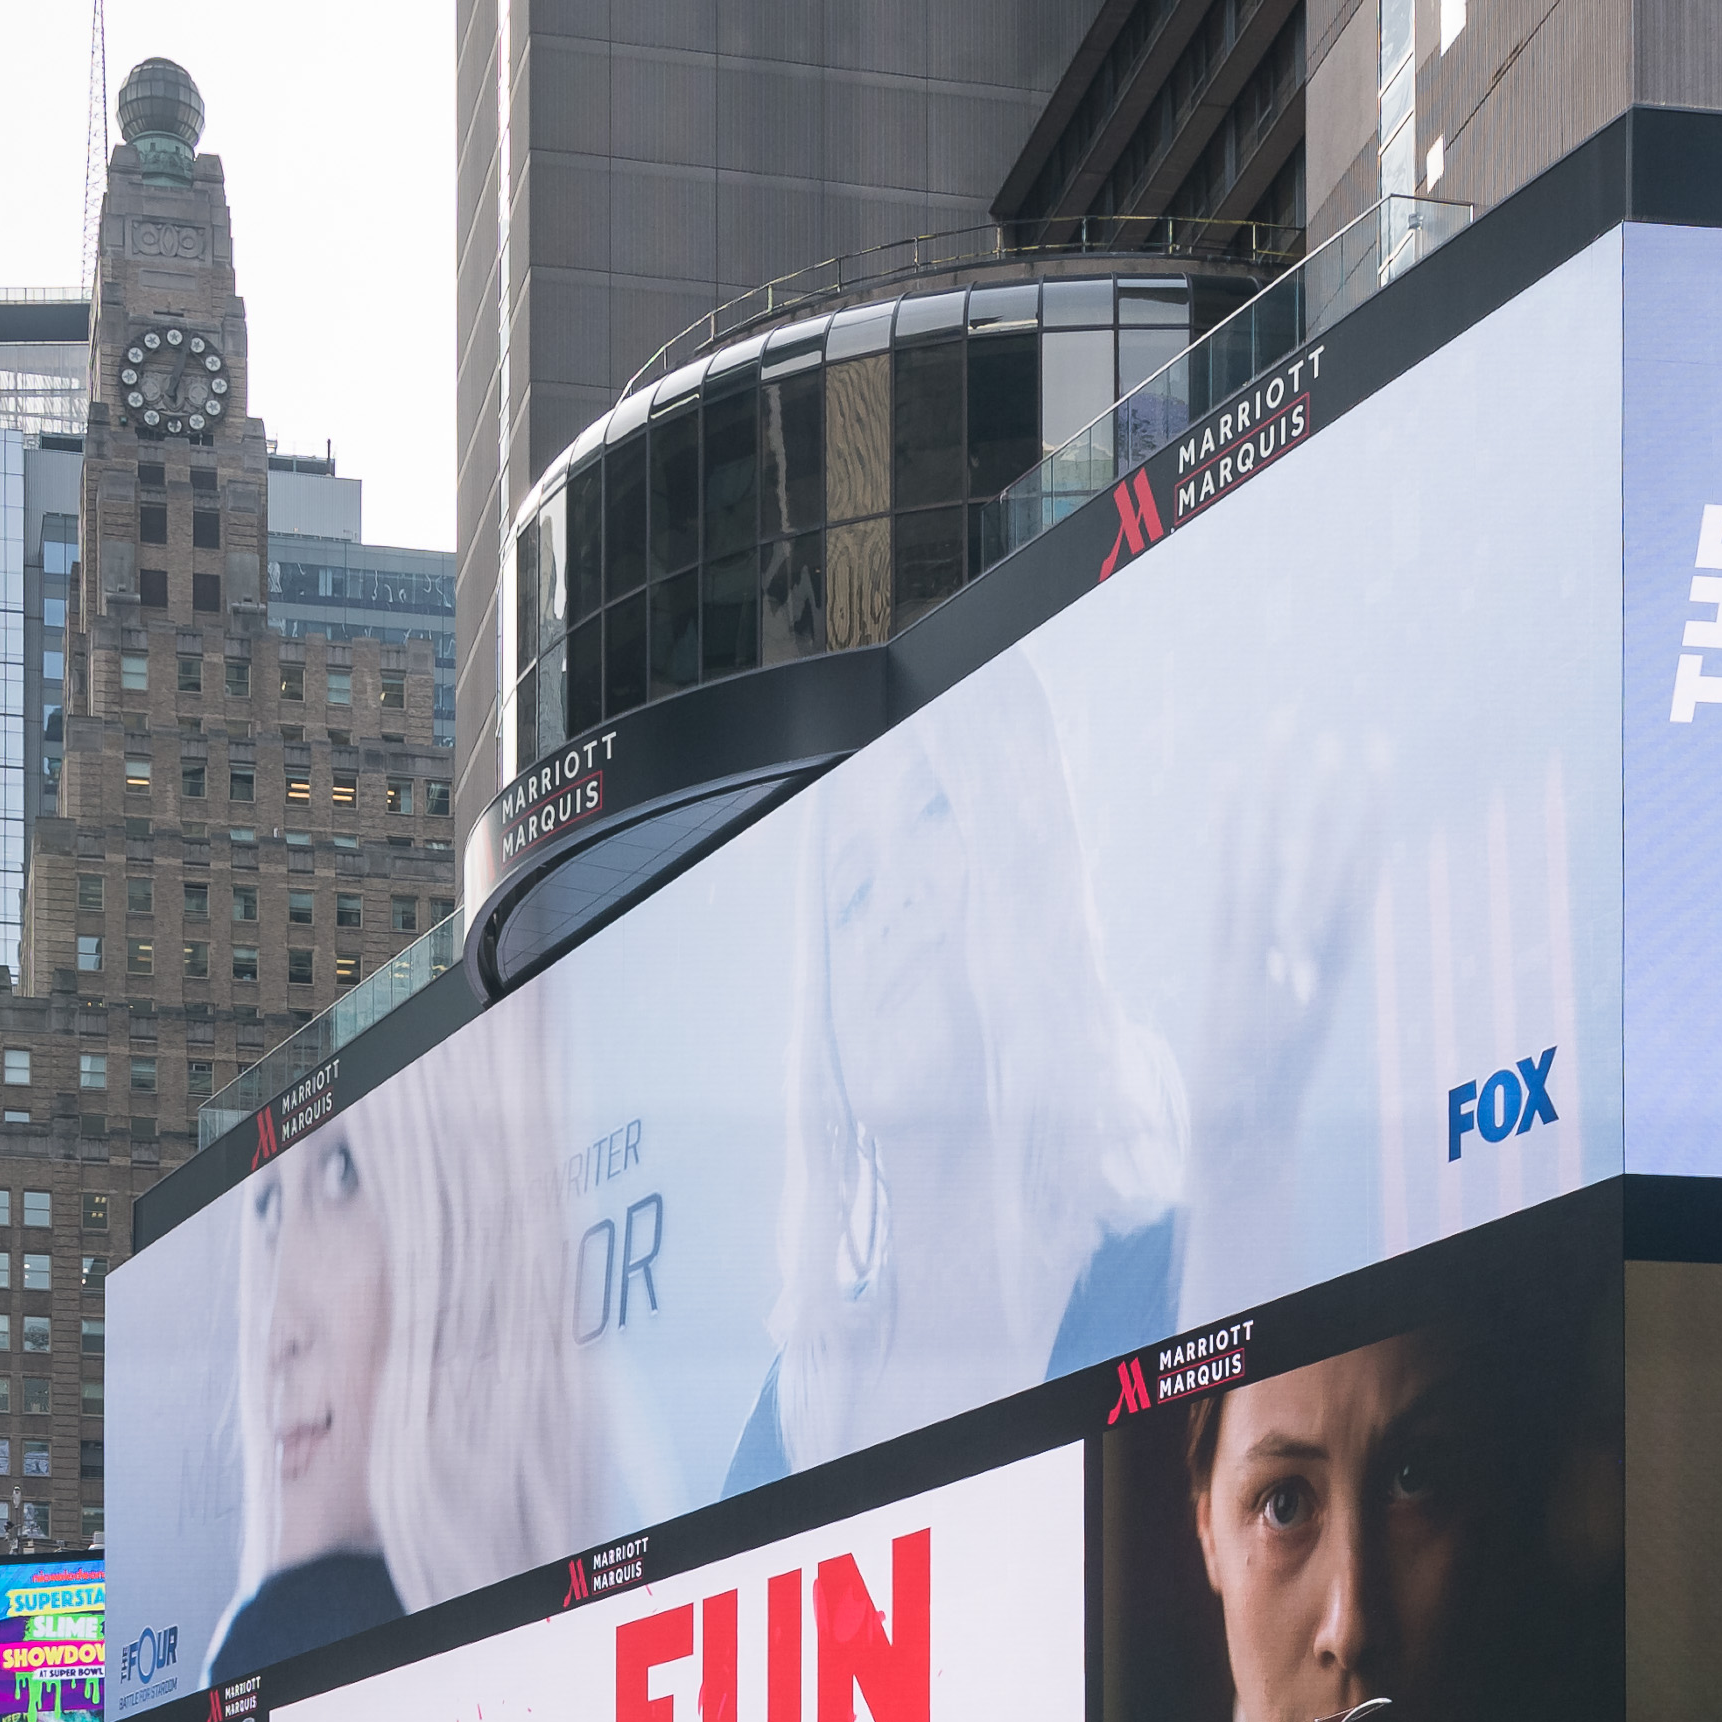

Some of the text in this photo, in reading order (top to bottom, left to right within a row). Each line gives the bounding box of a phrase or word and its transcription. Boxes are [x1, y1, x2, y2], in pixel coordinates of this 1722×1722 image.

[1177, 344, 1326, 475] MARRIOTT
[1176, 402, 1308, 518] MARQUIS
[500, 731, 618, 826] MARRIOTT
[500, 778, 602, 865] MARQUIS
[281, 1058, 340, 1116] MARRIOTT
[1448, 1046, 1559, 1163] FOX
[281, 1091, 333, 1142] MARQUIS
[1158, 1319, 1256, 1371] MARRIOTT
[1158, 1352, 1243, 1402] MARQUIS
[591, 1536, 649, 1569] MARRIOTT
[591, 1560, 645, 1593] MARQUIS
[32, 1616, 98, 1639] SLIME
[128, 1625, 179, 1685] FOUR
[224, 1675, 261, 1700] MARRIOTT
[224, 1695, 258, 1718] MARQUIS
